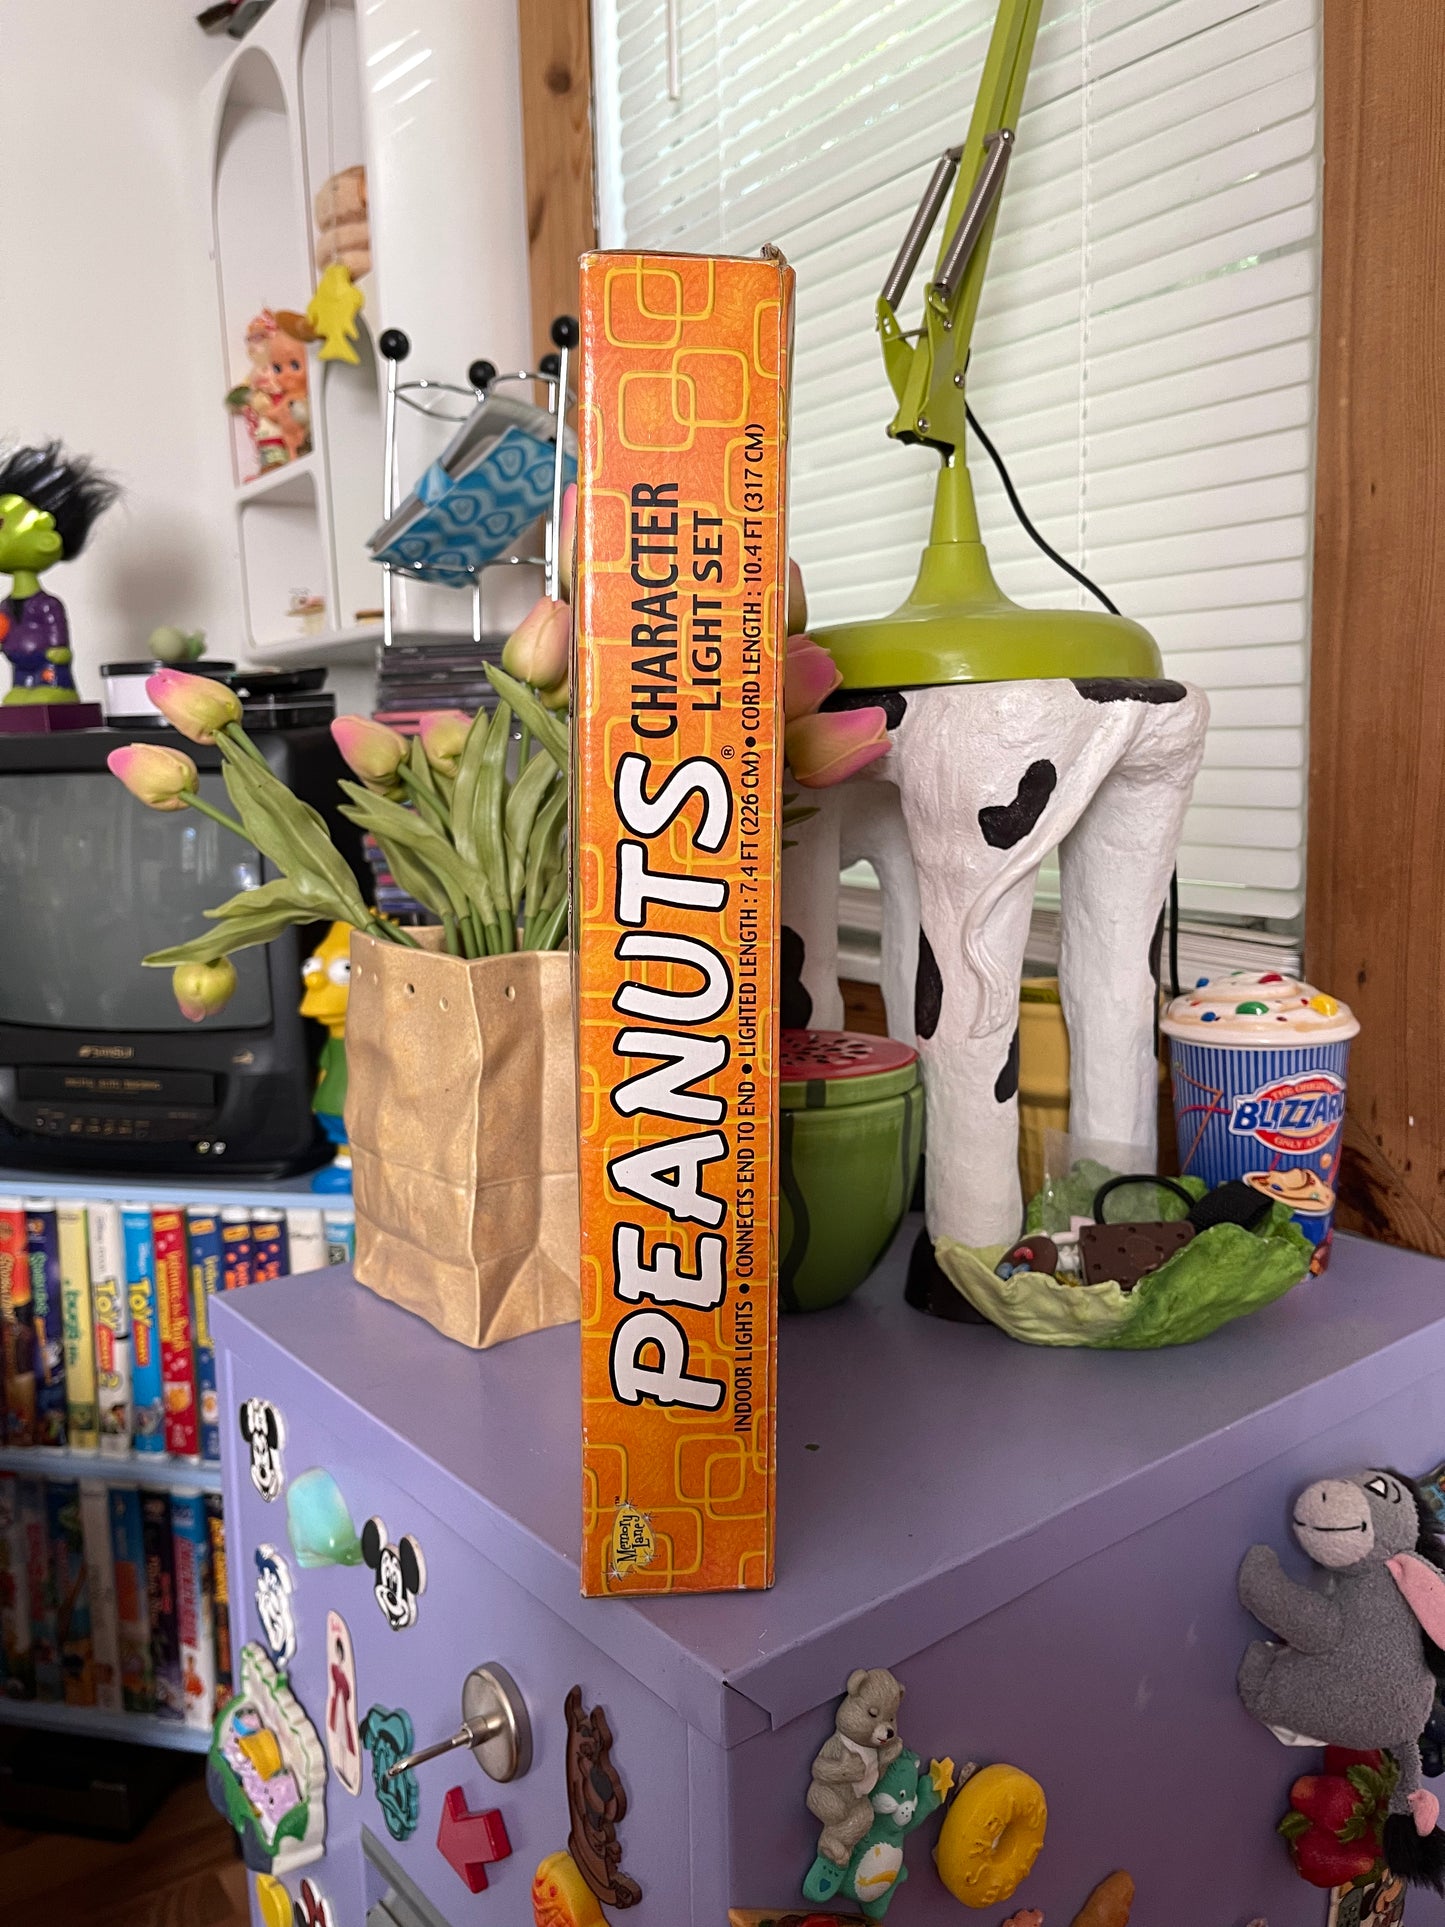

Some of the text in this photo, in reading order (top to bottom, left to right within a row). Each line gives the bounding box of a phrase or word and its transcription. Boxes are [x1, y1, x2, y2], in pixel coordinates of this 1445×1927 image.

[743, 423, 765, 463] CM)
[743, 468, 765, 513] (317
[743, 517, 763, 539] FT
[743, 544, 762, 584] 10.4
[630, 482, 679, 739] CHARACTER
[691, 510, 723, 711] LIGHT SET
[741, 681, 760, 731] CORD
[740, 751, 761, 789] CM)
[739, 793, 761, 836] (226
[740, 840, 759, 860] FT
[740, 866, 758, 894] 7.4
[738, 982, 758, 1057] LIGHTED
[737, 1081, 756, 1116] END
[737, 1121, 756, 1144] TO
[736, 1148, 755, 1183] END
[735, 1188, 755, 1278] CONNECTS
[734, 1300, 753, 1362] LIGHTS
[733, 1366, 753, 1433] INDOOR
[616, 1514, 640, 1564] Memory
[631, 1522, 651, 1549] Lane
